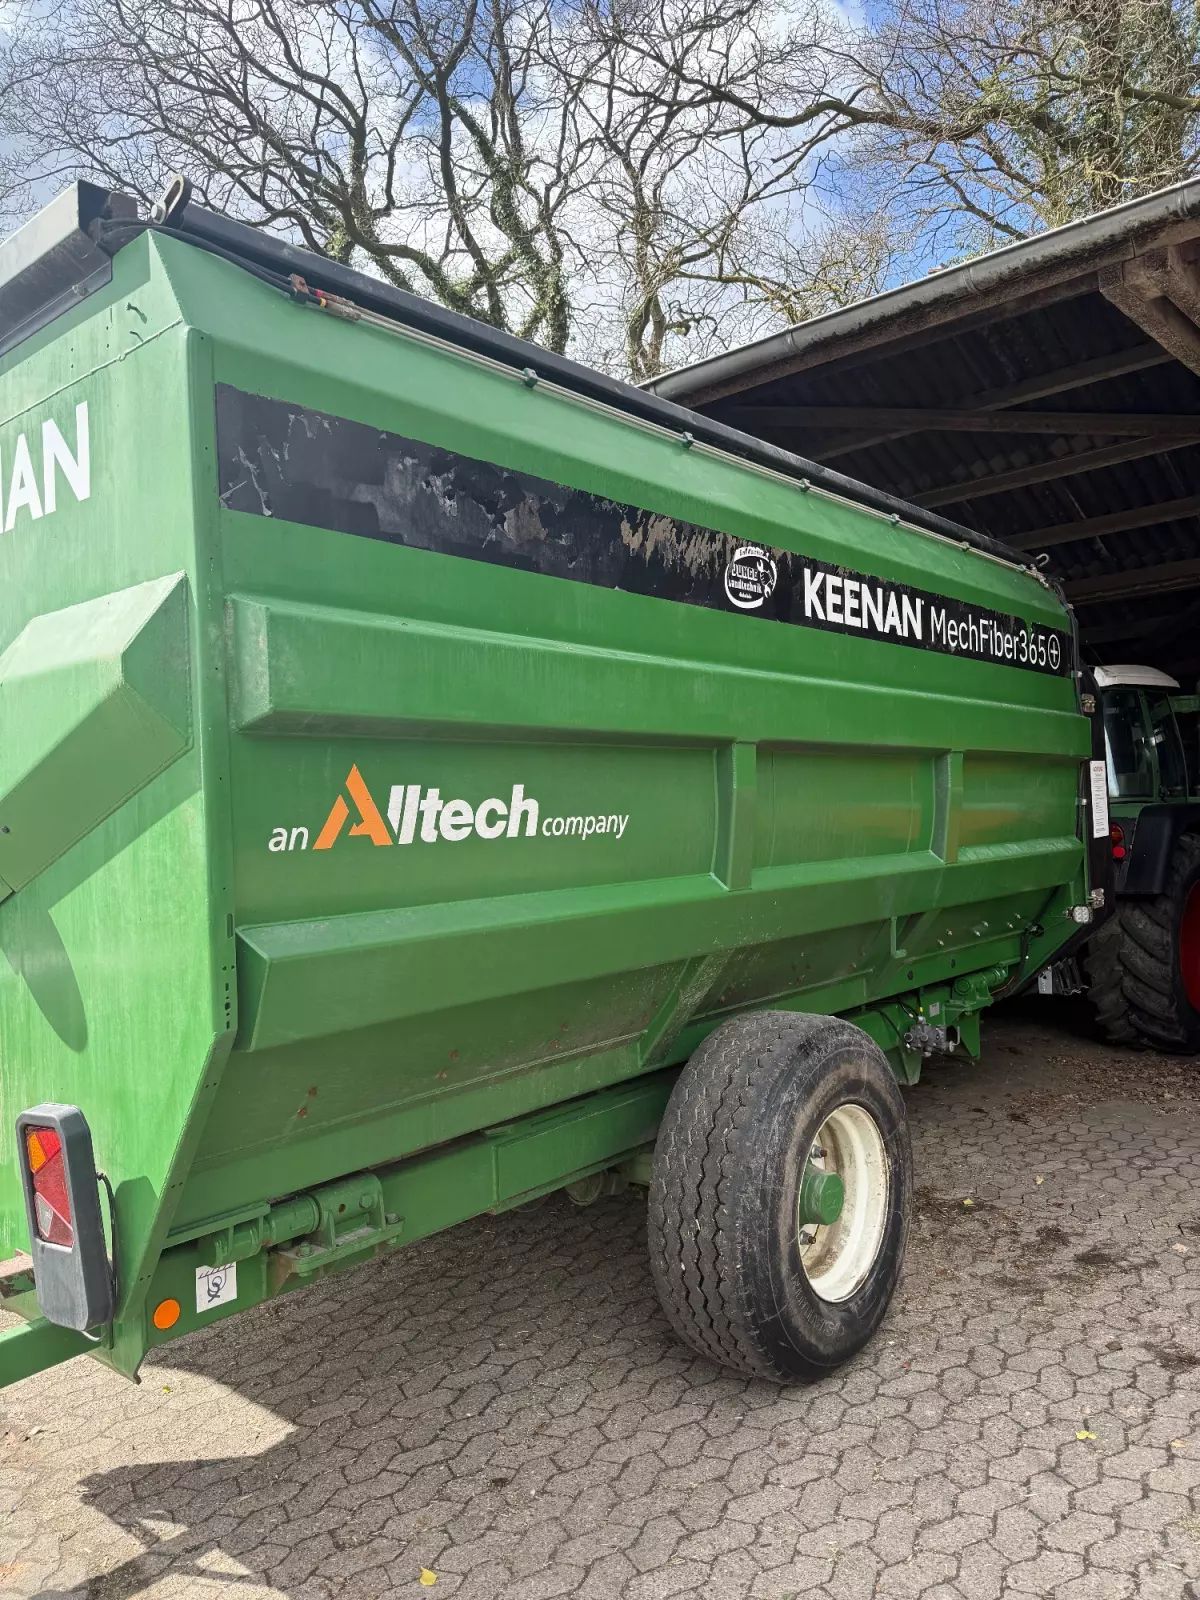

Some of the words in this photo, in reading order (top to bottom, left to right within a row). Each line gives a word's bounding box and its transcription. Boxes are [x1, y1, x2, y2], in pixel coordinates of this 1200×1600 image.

[0, 400, 91, 534] AN
[803, 567, 923, 640] KEENAN
[268, 826, 309, 852] an
[312, 763, 539, 850] Alltech
[542, 812, 630, 841] company
